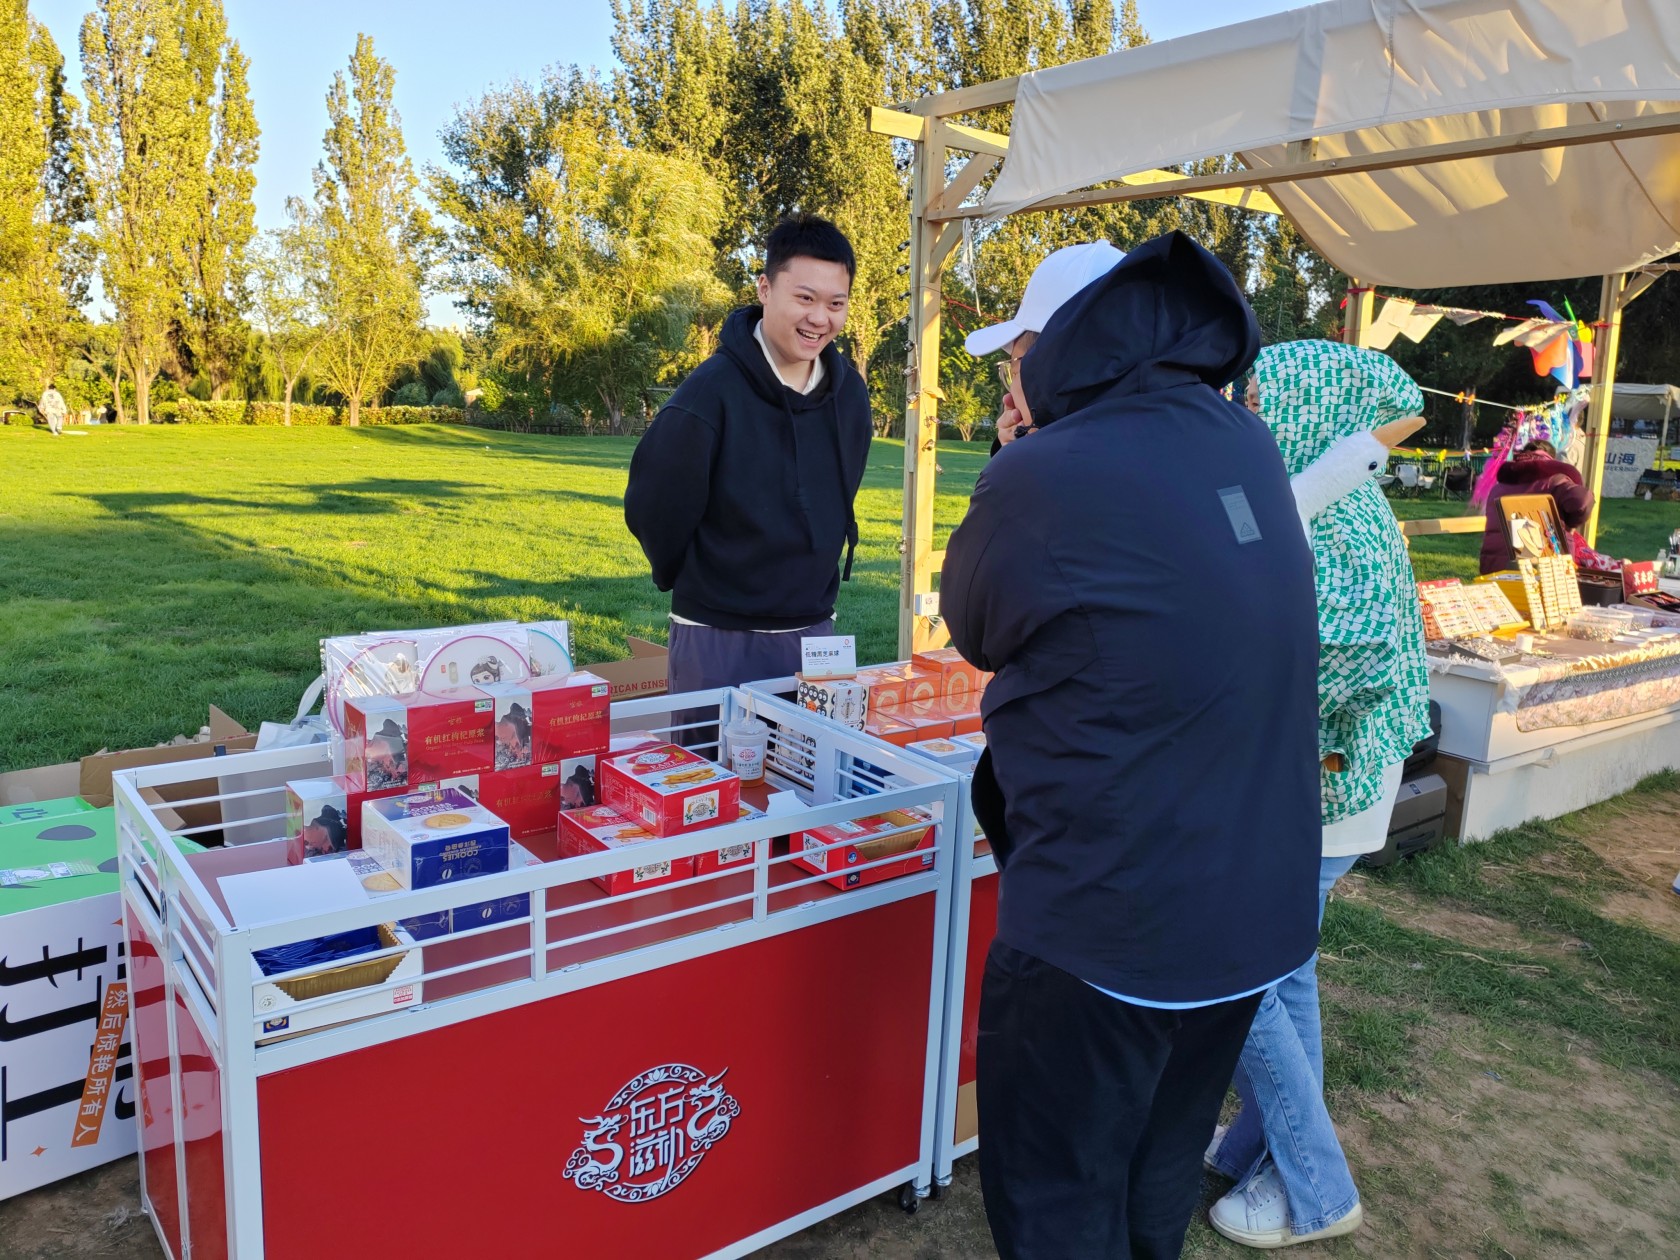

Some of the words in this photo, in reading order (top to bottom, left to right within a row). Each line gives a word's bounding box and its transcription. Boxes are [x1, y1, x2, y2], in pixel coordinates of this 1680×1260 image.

[424, 728, 486, 745] 有机红枸杞原浆
[442, 849, 479, 863] COOKIES
[74, 987, 127, 1141] 然后惊艳所有人
[629, 1084, 685, 1138] 东方
[629, 1125, 685, 1188] 滋补
